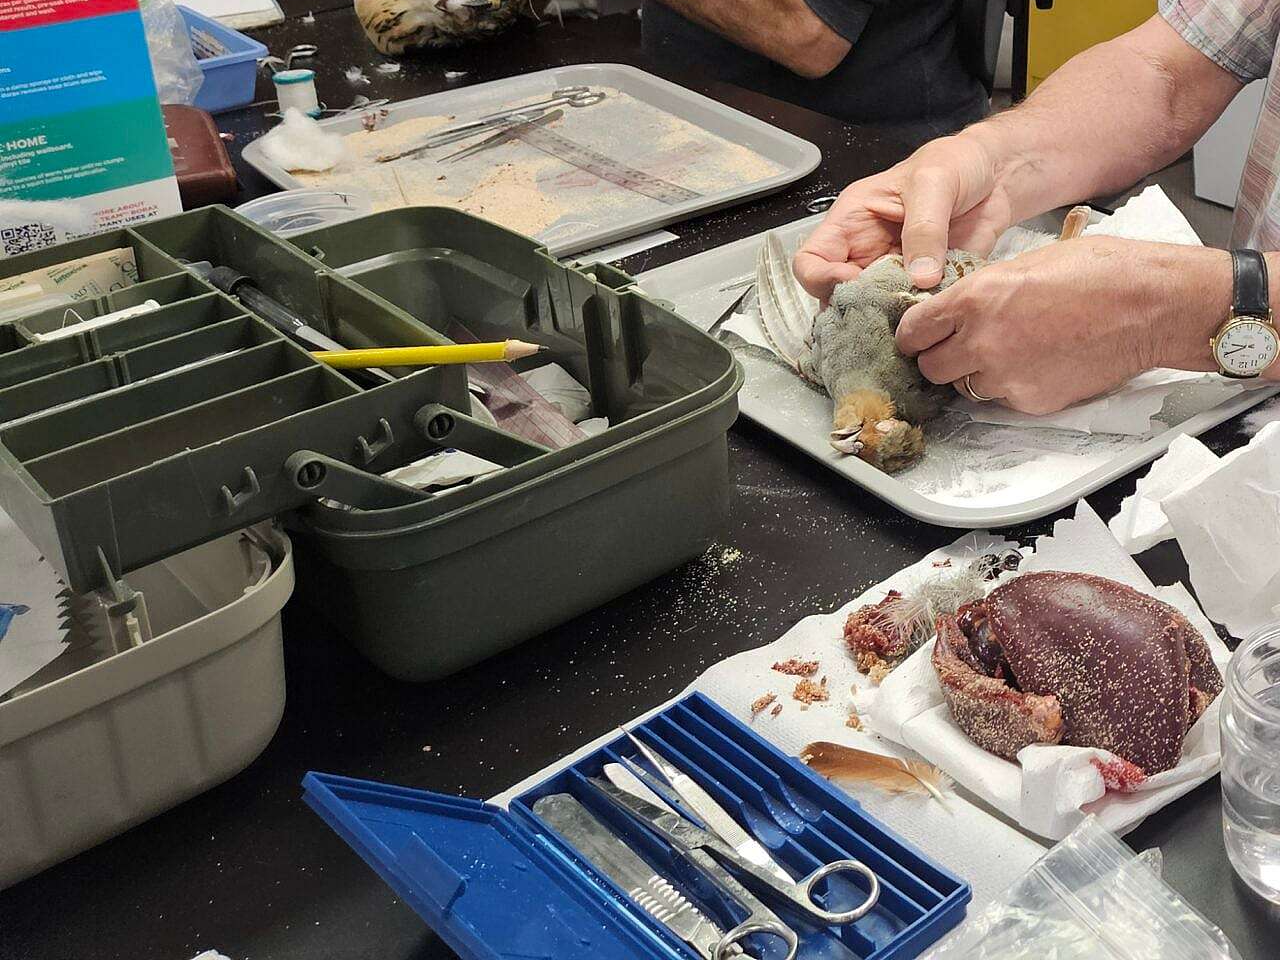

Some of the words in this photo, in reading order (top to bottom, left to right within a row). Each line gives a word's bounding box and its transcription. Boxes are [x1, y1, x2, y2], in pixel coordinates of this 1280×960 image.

[6, 135, 47, 150] HOME
[0, 151, 34, 161] including
[117, 201, 143, 211] ABOUT
[130, 205, 157, 214] BORAX
[99, 219, 121, 227] MANY
[125, 214, 145, 222] USES
[1238, 361, 1248, 369] 12
